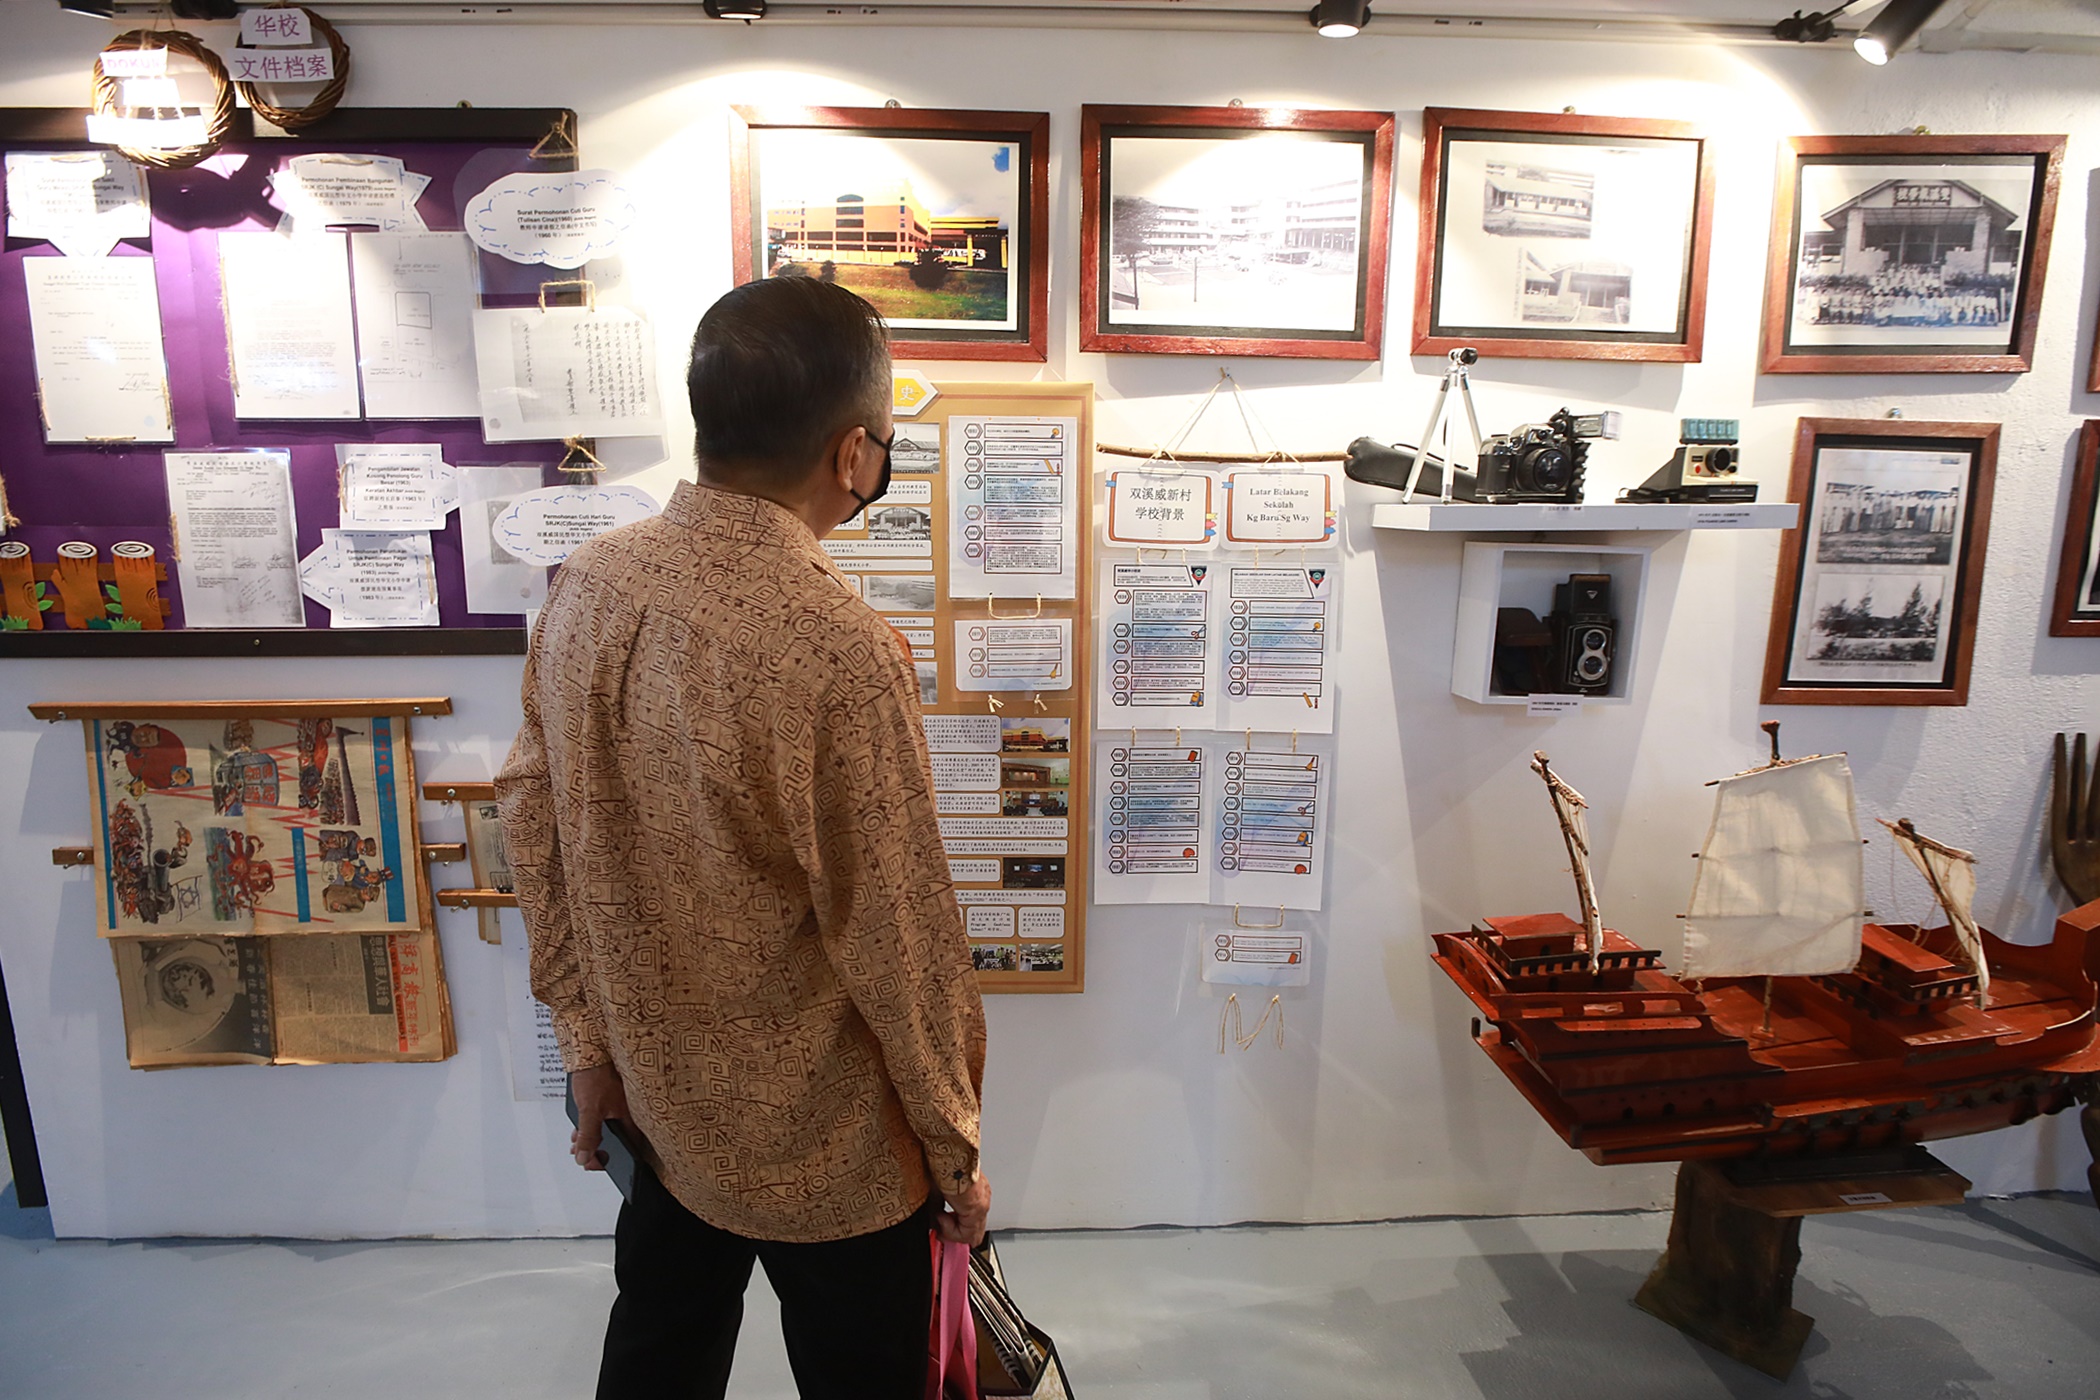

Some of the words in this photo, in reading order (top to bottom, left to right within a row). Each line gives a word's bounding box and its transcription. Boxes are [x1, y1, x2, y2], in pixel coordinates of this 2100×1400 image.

[254, 14, 300, 38] 华校
[235, 54, 327, 79] 文件档案
[899, 385, 915, 401] 史
[1129, 487, 1192, 502] 双溪威新村
[1250, 488, 1271, 496] Latar
[1273, 488, 1309, 497] Belakang
[1264, 501, 1294, 509] Sekolah
[1135, 506, 1185, 521] 学校背景
[1246, 514, 1258, 522] Kg
[1281, 514, 1291, 522] Sg
[1293, 514, 1310, 523] Way
